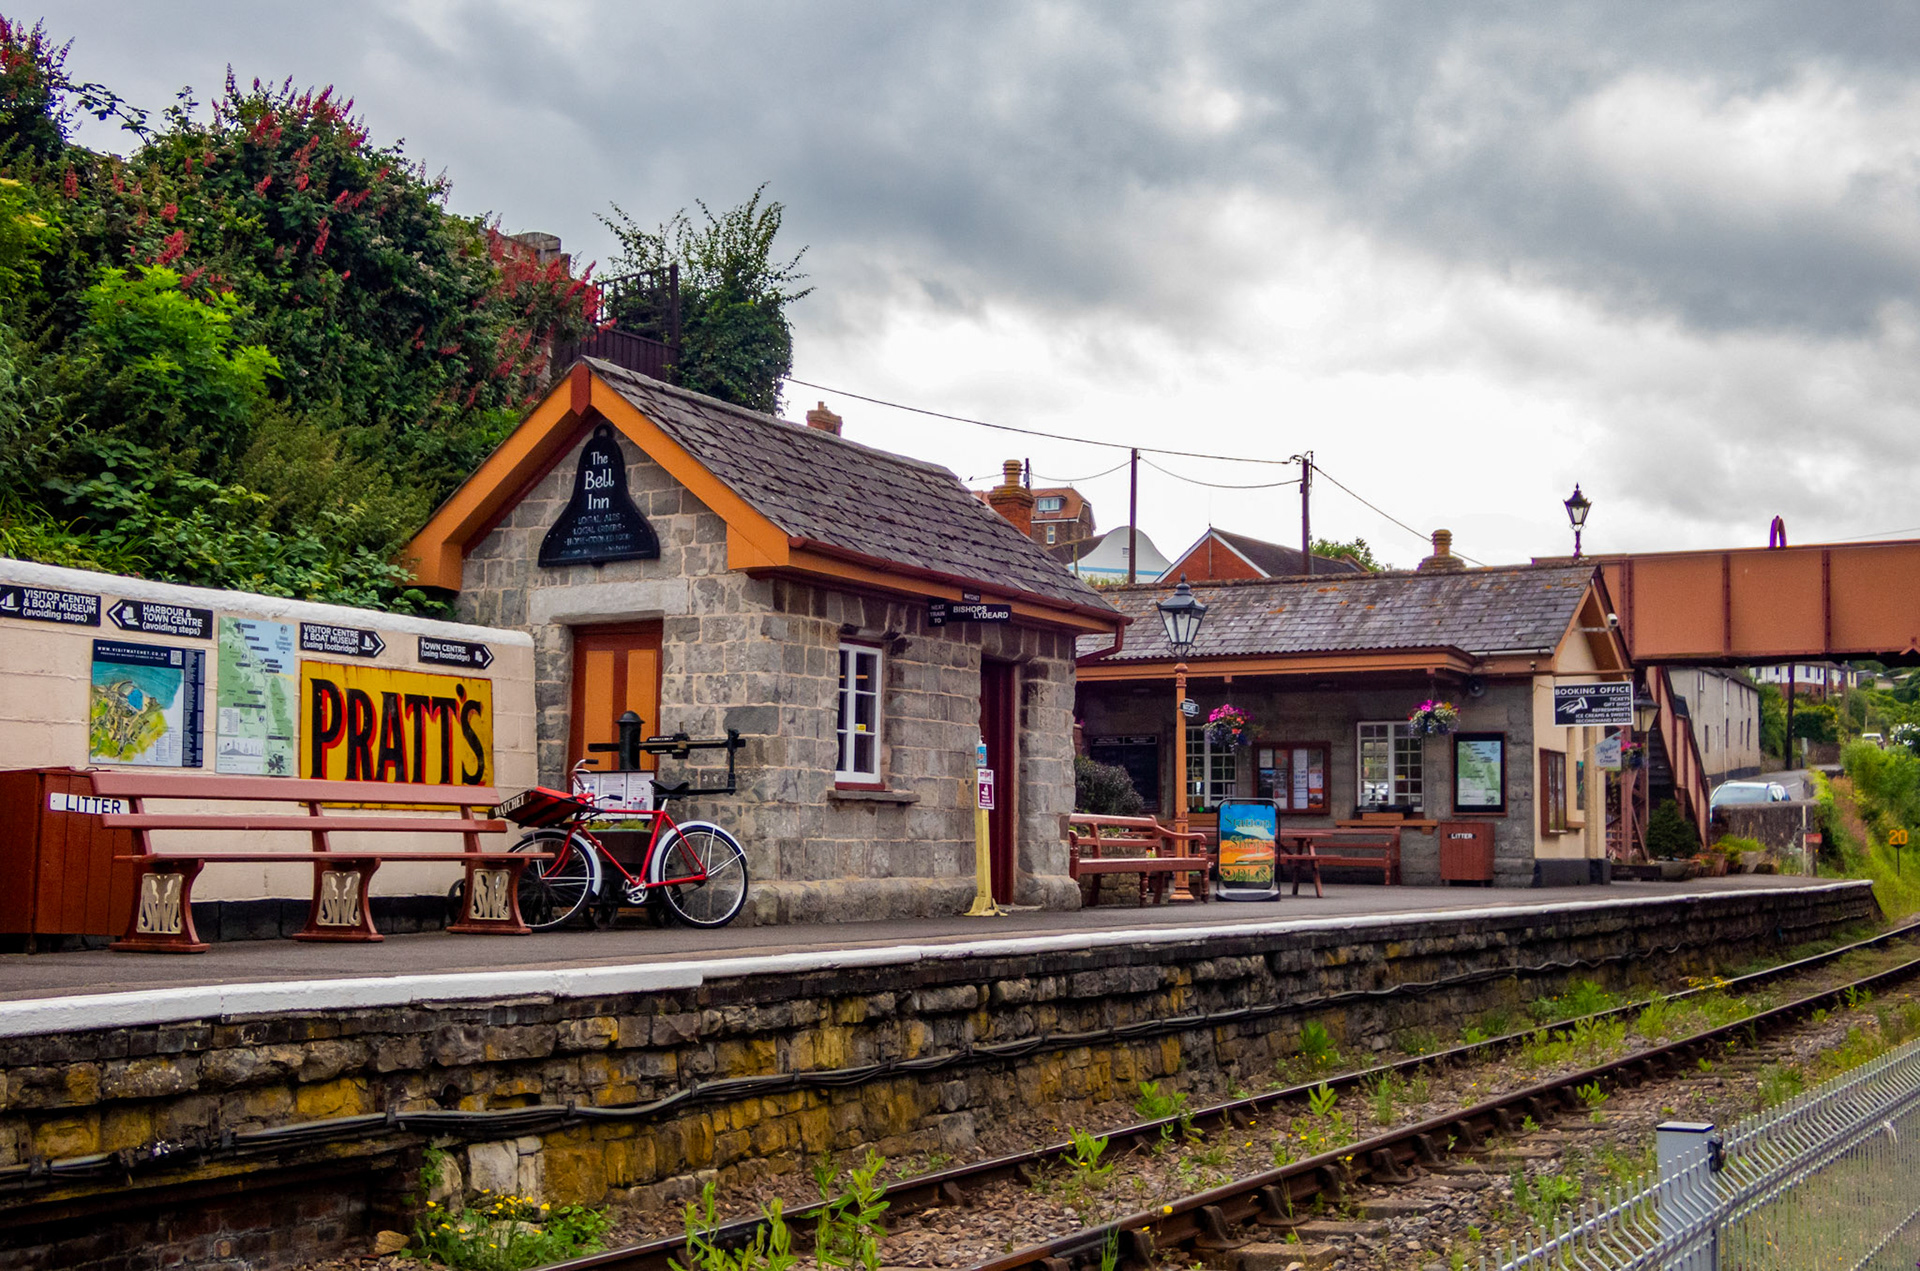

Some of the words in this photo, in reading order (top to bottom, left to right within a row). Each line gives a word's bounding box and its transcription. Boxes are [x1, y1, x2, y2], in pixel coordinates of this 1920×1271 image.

[591, 451, 609, 465] The
[584, 468, 615, 490] Bell
[588, 493, 610, 510] Inn
[24, 589, 60, 602] VISITOR
[61, 594, 97, 606] CENTRE
[23, 598, 30, 607] &
[31, 600, 57, 610] BOAT
[59, 602, 96, 615] MUSEUM
[142, 604, 184, 618] HARBOUR
[185, 609, 192, 618] &
[952, 605, 988, 614] BISHOPS
[22, 607, 62, 621] (avoiding
[63, 611, 88, 623] steps)
[143, 613, 169, 623] TOWN
[170, 616, 203, 628] CENTRE
[973, 611, 1009, 619] LYDEARD
[142, 621, 177, 634] (avoiding
[178, 625, 201, 636] steps)
[303, 624, 332, 636] VISITOR
[332, 628, 359, 639] CENTRE
[303, 632, 309, 640] &
[310, 633, 330, 643] BOAT
[330, 636, 359, 646] MUSEUM
[303, 640, 323, 651] (using
[324, 642, 359, 655] footbridge)
[421, 641, 441, 650] TOWN
[441, 644, 467, 654] CENTRE
[420, 649, 439, 659] (using
[439, 651, 471, 662] footbridge)
[1599, 685, 1630, 694] OFFICE
[310, 678, 486, 786] PRATT'S
[65, 794, 121, 814] LITTER
[494, 793, 525, 817] WATCHET
[1224, 814, 1271, 828] Station
[1229, 835, 1266, 853] Shop
[1888, 829, 1909, 845] 20
